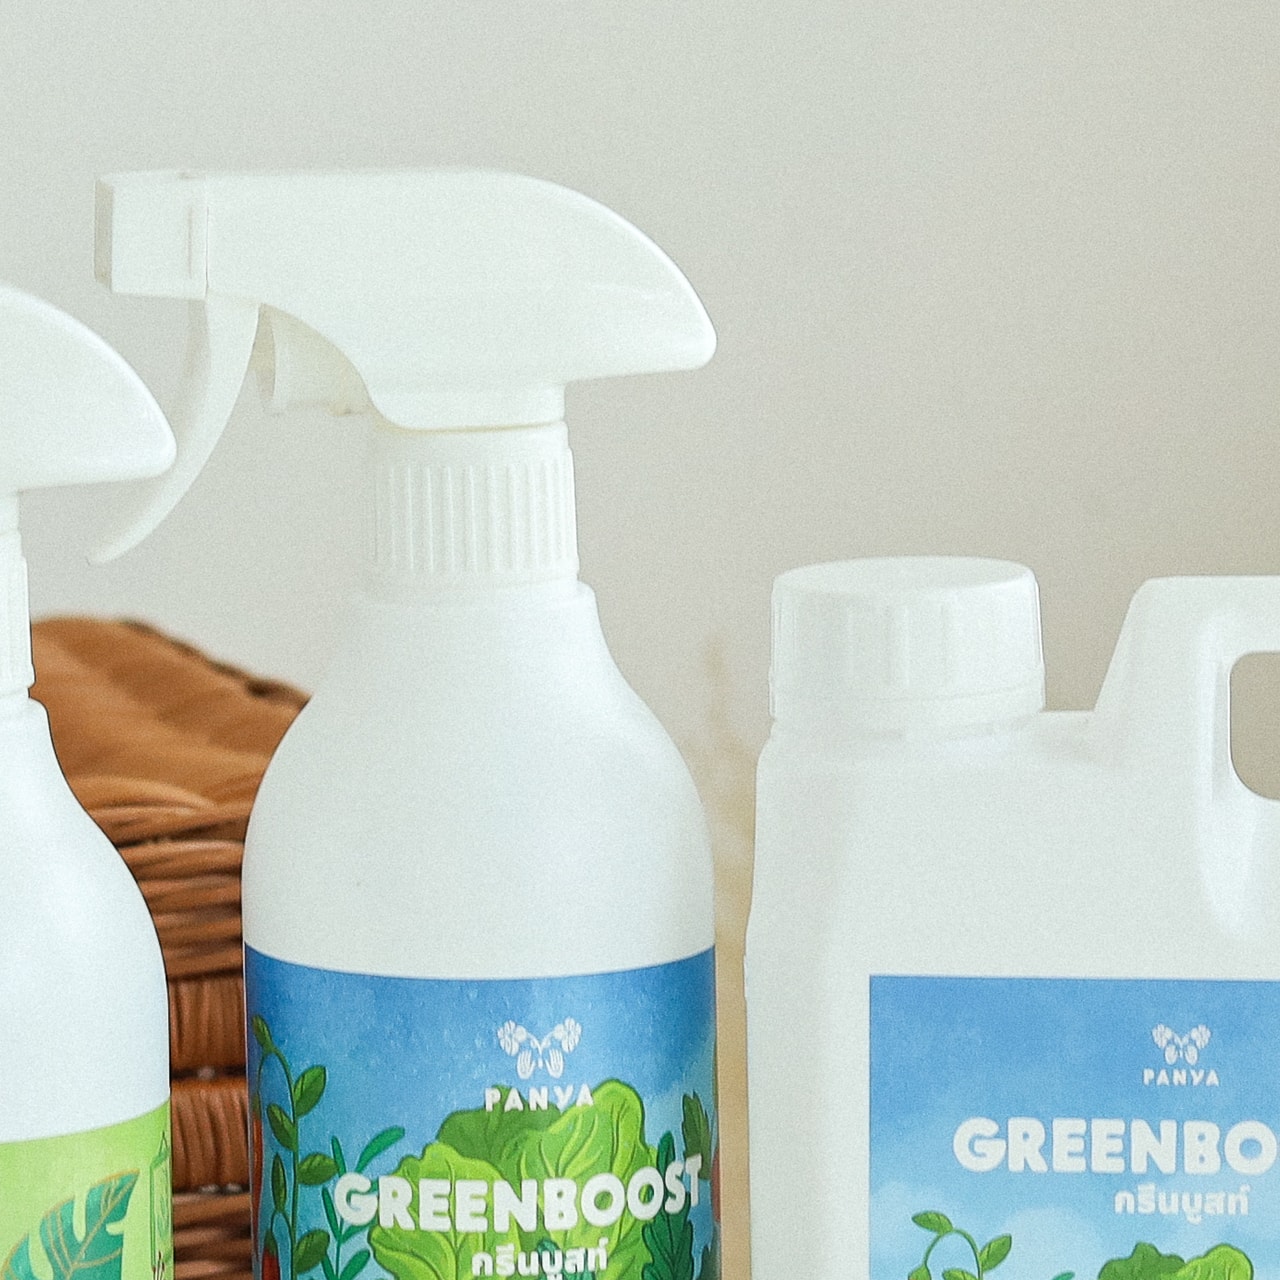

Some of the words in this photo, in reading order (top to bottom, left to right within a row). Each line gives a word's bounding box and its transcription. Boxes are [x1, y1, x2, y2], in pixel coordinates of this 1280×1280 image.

[1143, 1069, 1220, 1086] PANYA
[485, 1083, 594, 1112] PANYA
[334, 1153, 704, 1233] GREENBOOST
